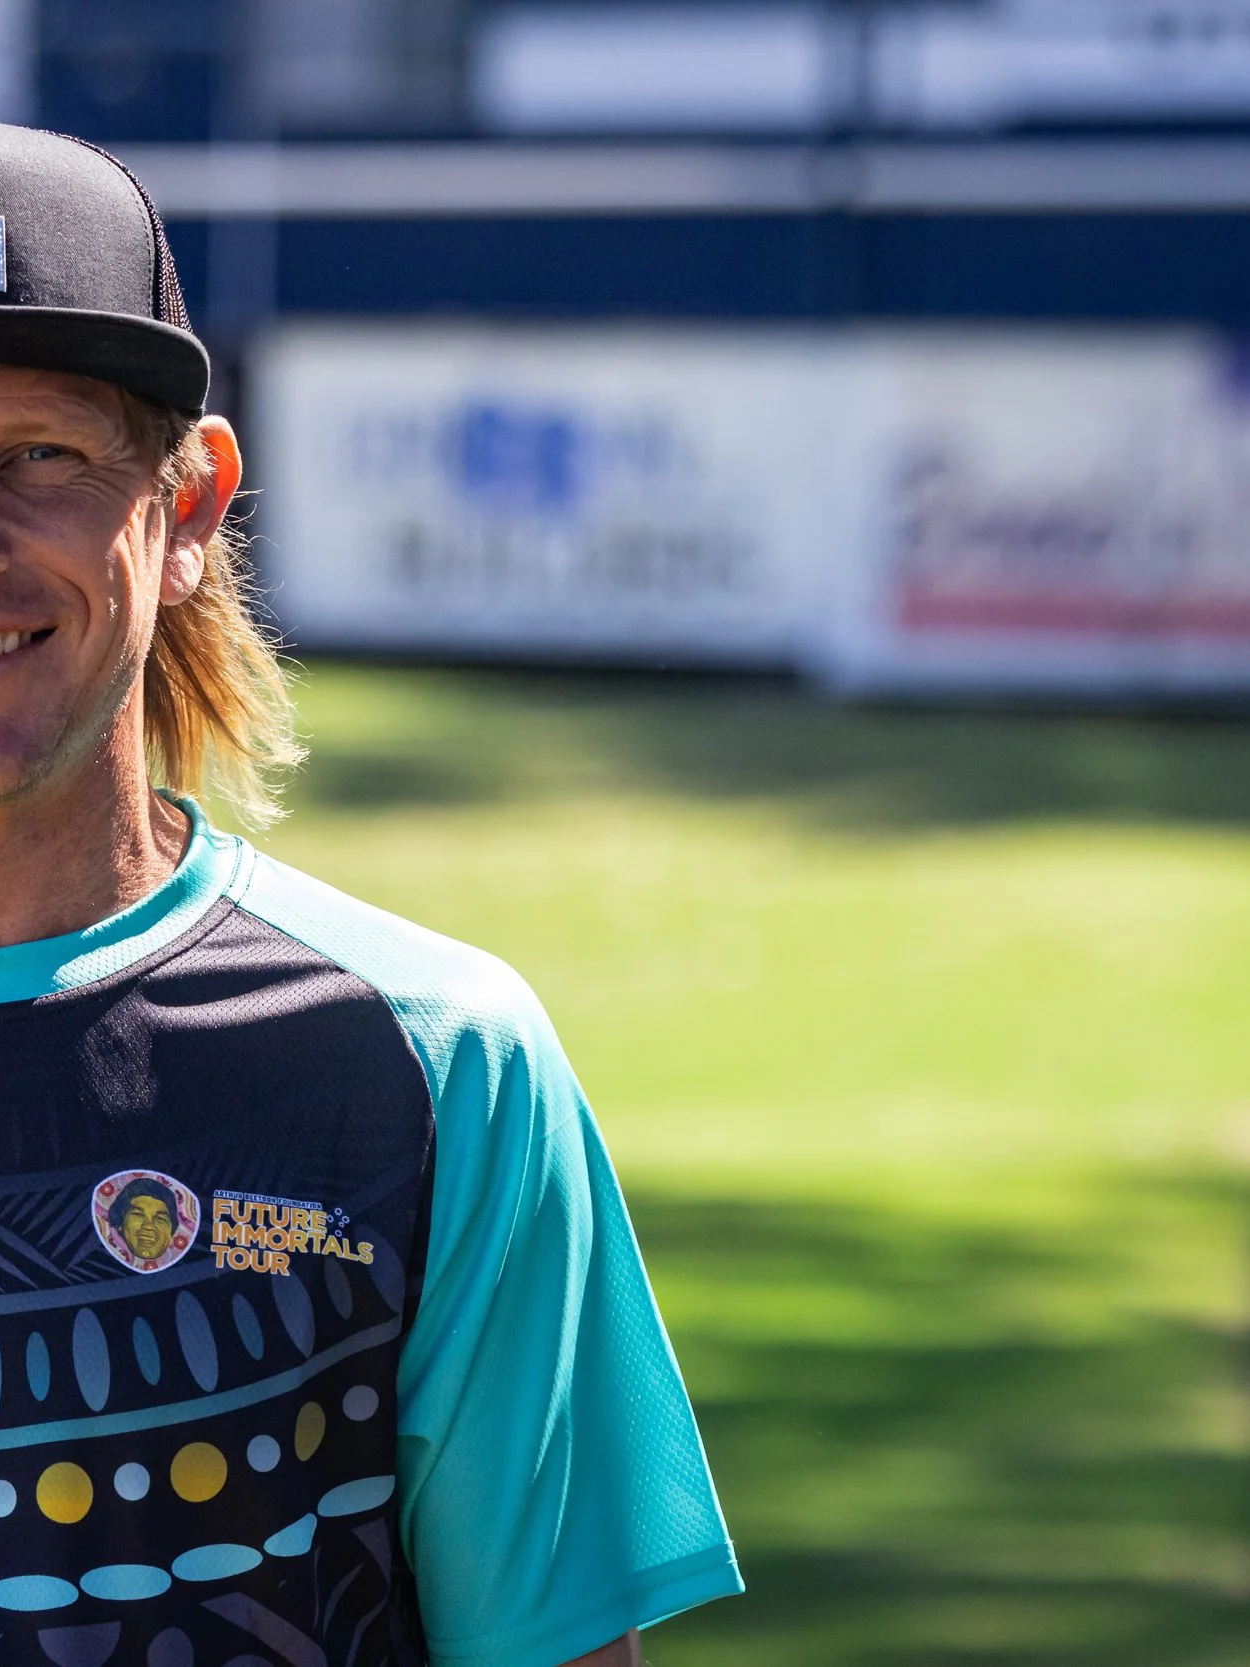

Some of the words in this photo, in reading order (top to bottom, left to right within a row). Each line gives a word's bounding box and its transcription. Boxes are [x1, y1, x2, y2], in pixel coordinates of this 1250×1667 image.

[213, 1190, 243, 1200] ARTHUR
[278, 1197, 323, 1210] FOUNDATION
[213, 1199, 327, 1233] FUTURE
[212, 1221, 374, 1265] IMMORTALS
[211, 1245, 290, 1276] TOUR
